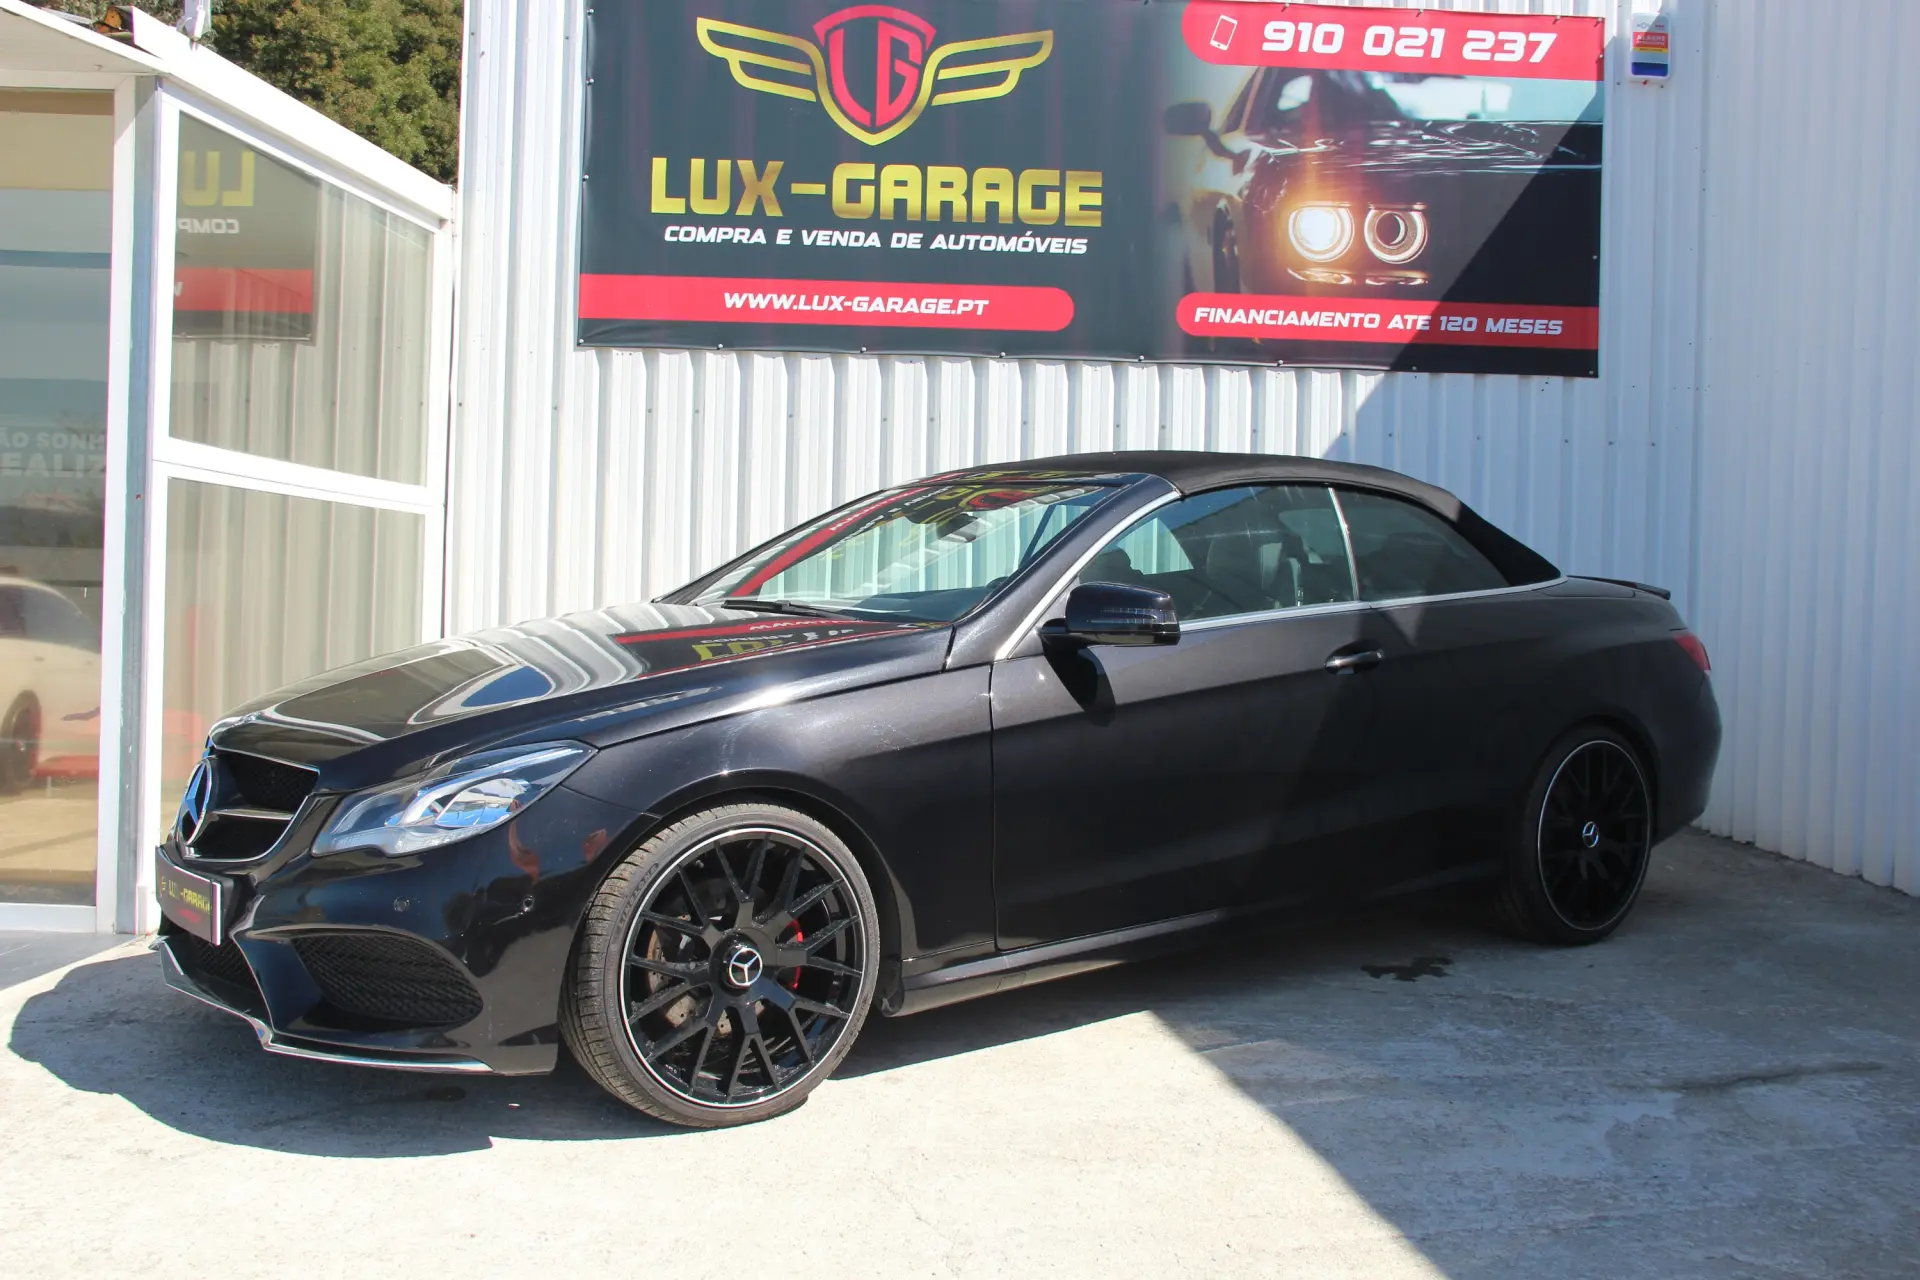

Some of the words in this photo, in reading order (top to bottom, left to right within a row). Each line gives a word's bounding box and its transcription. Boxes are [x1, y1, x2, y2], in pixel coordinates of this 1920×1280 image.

[1262, 20, 1345, 54] 910
[1362, 25, 1445, 58] 021
[1462, 30, 1557, 63] 237
[651, 157, 1102, 227] LUX-GARAGE
[664, 225, 767, 244] COMPRA
[776, 229, 793, 244] E
[801, 230, 881, 247] VENDA
[890, 232, 923, 249] DE
[930, 231, 1088, 254] AUTOMÓVEIS
[724, 292, 989, 315] WWW.LUX-GARAGE.PT
[1194, 307, 1381, 329] FINANCIAMENTO
[1387, 314, 1431, 331] ATE
[1440, 316, 1478, 332] 120
[1485, 318, 1563, 335] MESES
